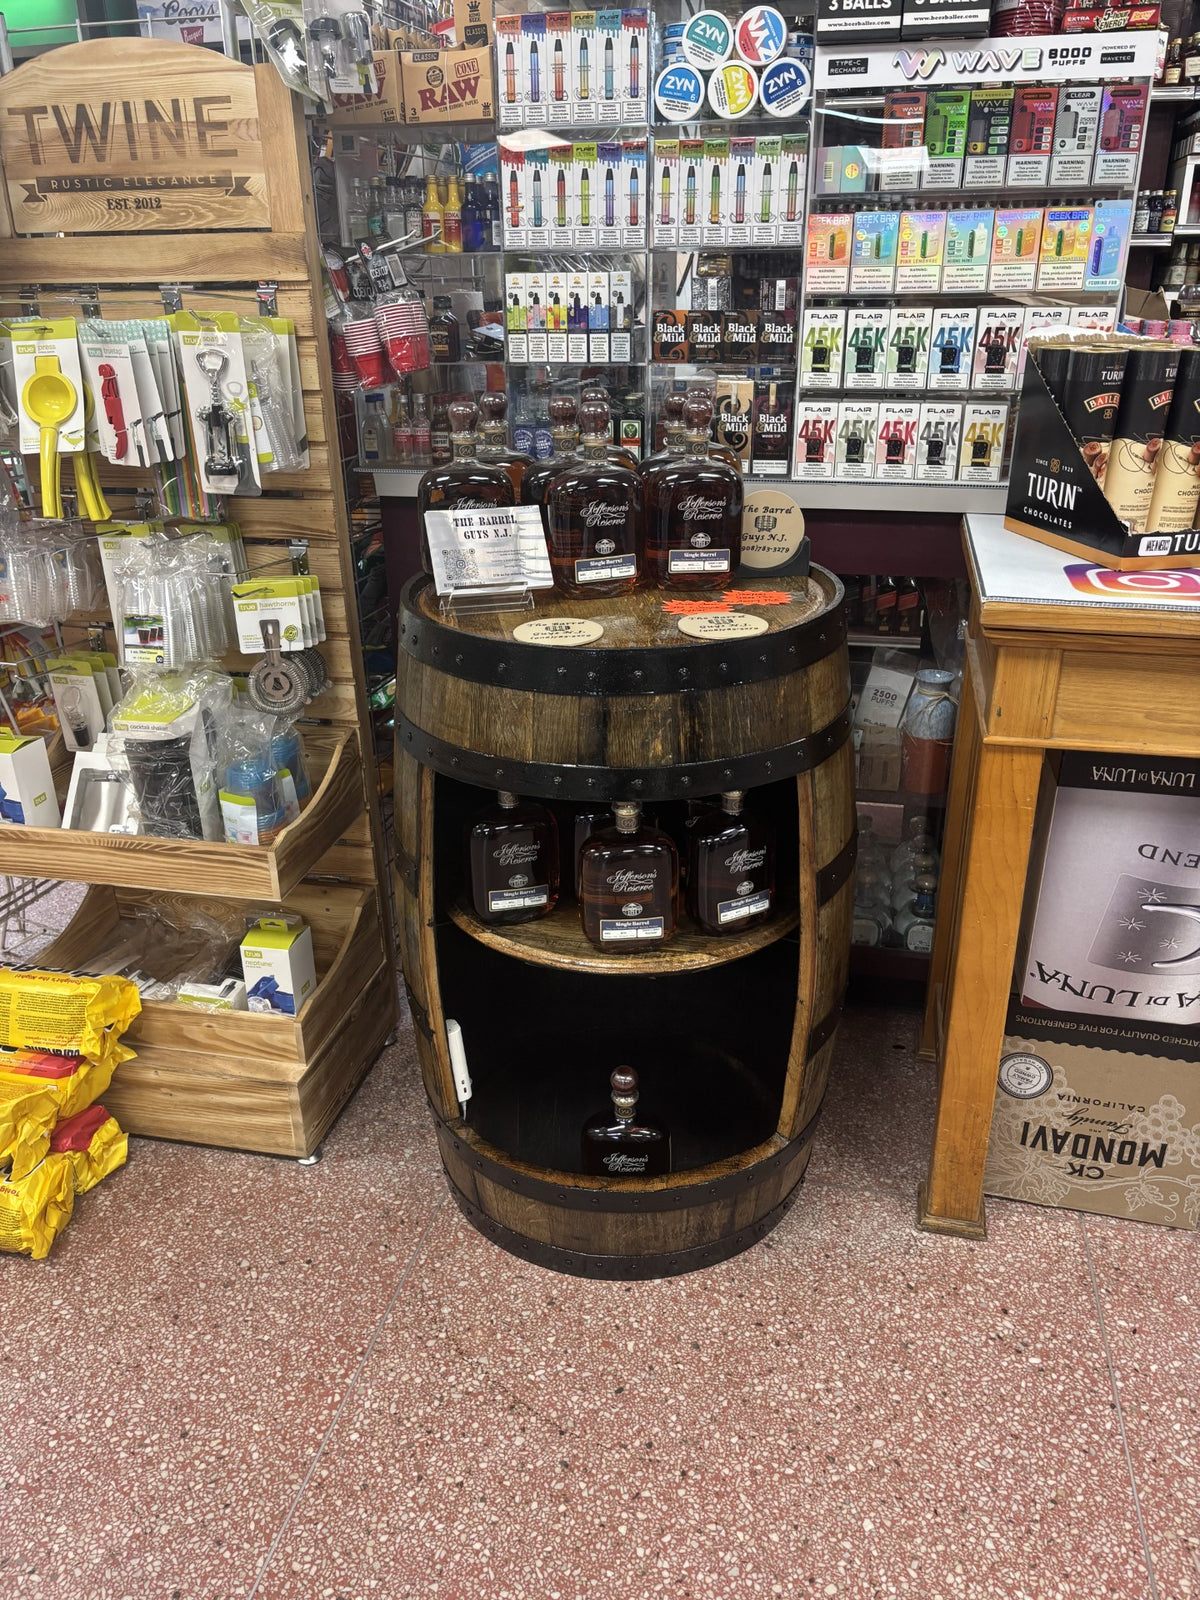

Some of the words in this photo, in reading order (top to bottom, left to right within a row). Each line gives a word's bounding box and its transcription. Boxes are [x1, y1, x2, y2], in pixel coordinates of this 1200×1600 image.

[466, 27, 488, 37] CLASSIC
[694, 20, 726, 44] ZYN
[717, 45, 723, 53] 6
[747, 10, 777, 61] ZYN
[413, 53, 439, 62] CLASSIC
[952, 47, 1043, 73] WAVE
[1049, 47, 1092, 59] 8000
[457, 61, 477, 77] CONE
[829, 66, 866, 74] RECHARGE
[1051, 59, 1086, 67] PUFFS
[665, 75, 696, 93] ZYN
[731, 69, 748, 105] ZYN
[766, 67, 797, 94] ZYN
[797, 78, 802, 86] 6
[418, 76, 481, 112] RAW
[410, 107, 417, 116] 3
[8, 95, 238, 166] TWINE
[51, 177, 112, 190] RUSTIC
[123, 175, 218, 188] ELEGANCE
[107, 198, 132, 210] EST.
[134, 197, 162, 210] 2012
[1049, 211, 1071, 221] GEEK
[1072, 211, 1090, 220] BAR
[657, 324, 685, 333] Black
[693, 323, 721, 332] Black
[728, 323, 756, 333] Black
[765, 323, 793, 333] Black
[661, 333, 685, 342] Mild
[698, 333, 721, 343] Mild
[733, 333, 756, 343] Mild
[769, 333, 793, 343] Mild
[804, 327, 842, 352] 45K
[848, 327, 887, 352] 45K
[890, 327, 929, 352] 45K
[933, 327, 973, 352] 45K
[979, 327, 1021, 352] 45K
[18, 346, 34, 354] true
[721, 413, 748, 422] Black
[759, 414, 787, 423] Black
[726, 423, 748, 431] Mild
[764, 423, 787, 432] Mild
[799, 420, 835, 443] 45K
[839, 420, 876, 443] 45K
[879, 421, 917, 445] 45K
[920, 422, 958, 445] 45K
[964, 423, 1005, 447] 45K
[1036, 458, 1048, 467] SINCE
[1027, 472, 1077, 511] TURIN
[580, 501, 629, 517] Jefferson's
[678, 495, 727, 511] Jefferson's
[743, 504, 759, 513] The
[762, 505, 794, 514] Barrel
[453, 518, 474, 528] THE
[478, 514, 517, 525] BARREL
[586, 514, 626, 528] Reserve
[683, 509, 723, 521] Reserve
[1023, 506, 1072, 529] CHOCOLATES
[464, 530, 489, 540] GUYS
[742, 533, 765, 542] Guys
[767, 534, 787, 542] N.J.
[590, 559, 606, 567] Single
[239, 603, 257, 611] true
[259, 600, 296, 608] hawthorne
[871, 696, 896, 707] PUFFS
[873, 689, 898, 701] 2500
[1092, 766, 1136, 783] LUNA
[1138, 772, 1148, 781] DI
[1151, 770, 1195, 788] LUNA
[493, 841, 540, 858] Jefferson's
[500, 854, 538, 866] Reserve
[729, 860, 763, 874] Reserve
[606, 869, 657, 885] Jefferson's
[613, 881, 653, 893] Reserve
[731, 900, 745, 908] Single
[746, 895, 761, 904] Barrel
[1036, 960, 1142, 1007] LUNA
[1147, 995, 1170, 1006] DI
[1015, 1014, 1077, 1030] GENERATIONS
[1078, 1023, 1098, 1033] FIVE
[1100, 1026, 1117, 1035] FOR
[1120, 1028, 1159, 1042] QUALITY
[1057, 1093, 1146, 1113] CALIFORNIA
[1062, 1108, 1134, 1134] Family
[1020, 1121, 1168, 1168] MONDAVI
[603, 1152, 649, 1167] Jefferson's
[607, 1163, 646, 1173] Reserve
[1067, 1162, 1105, 1180] CK
